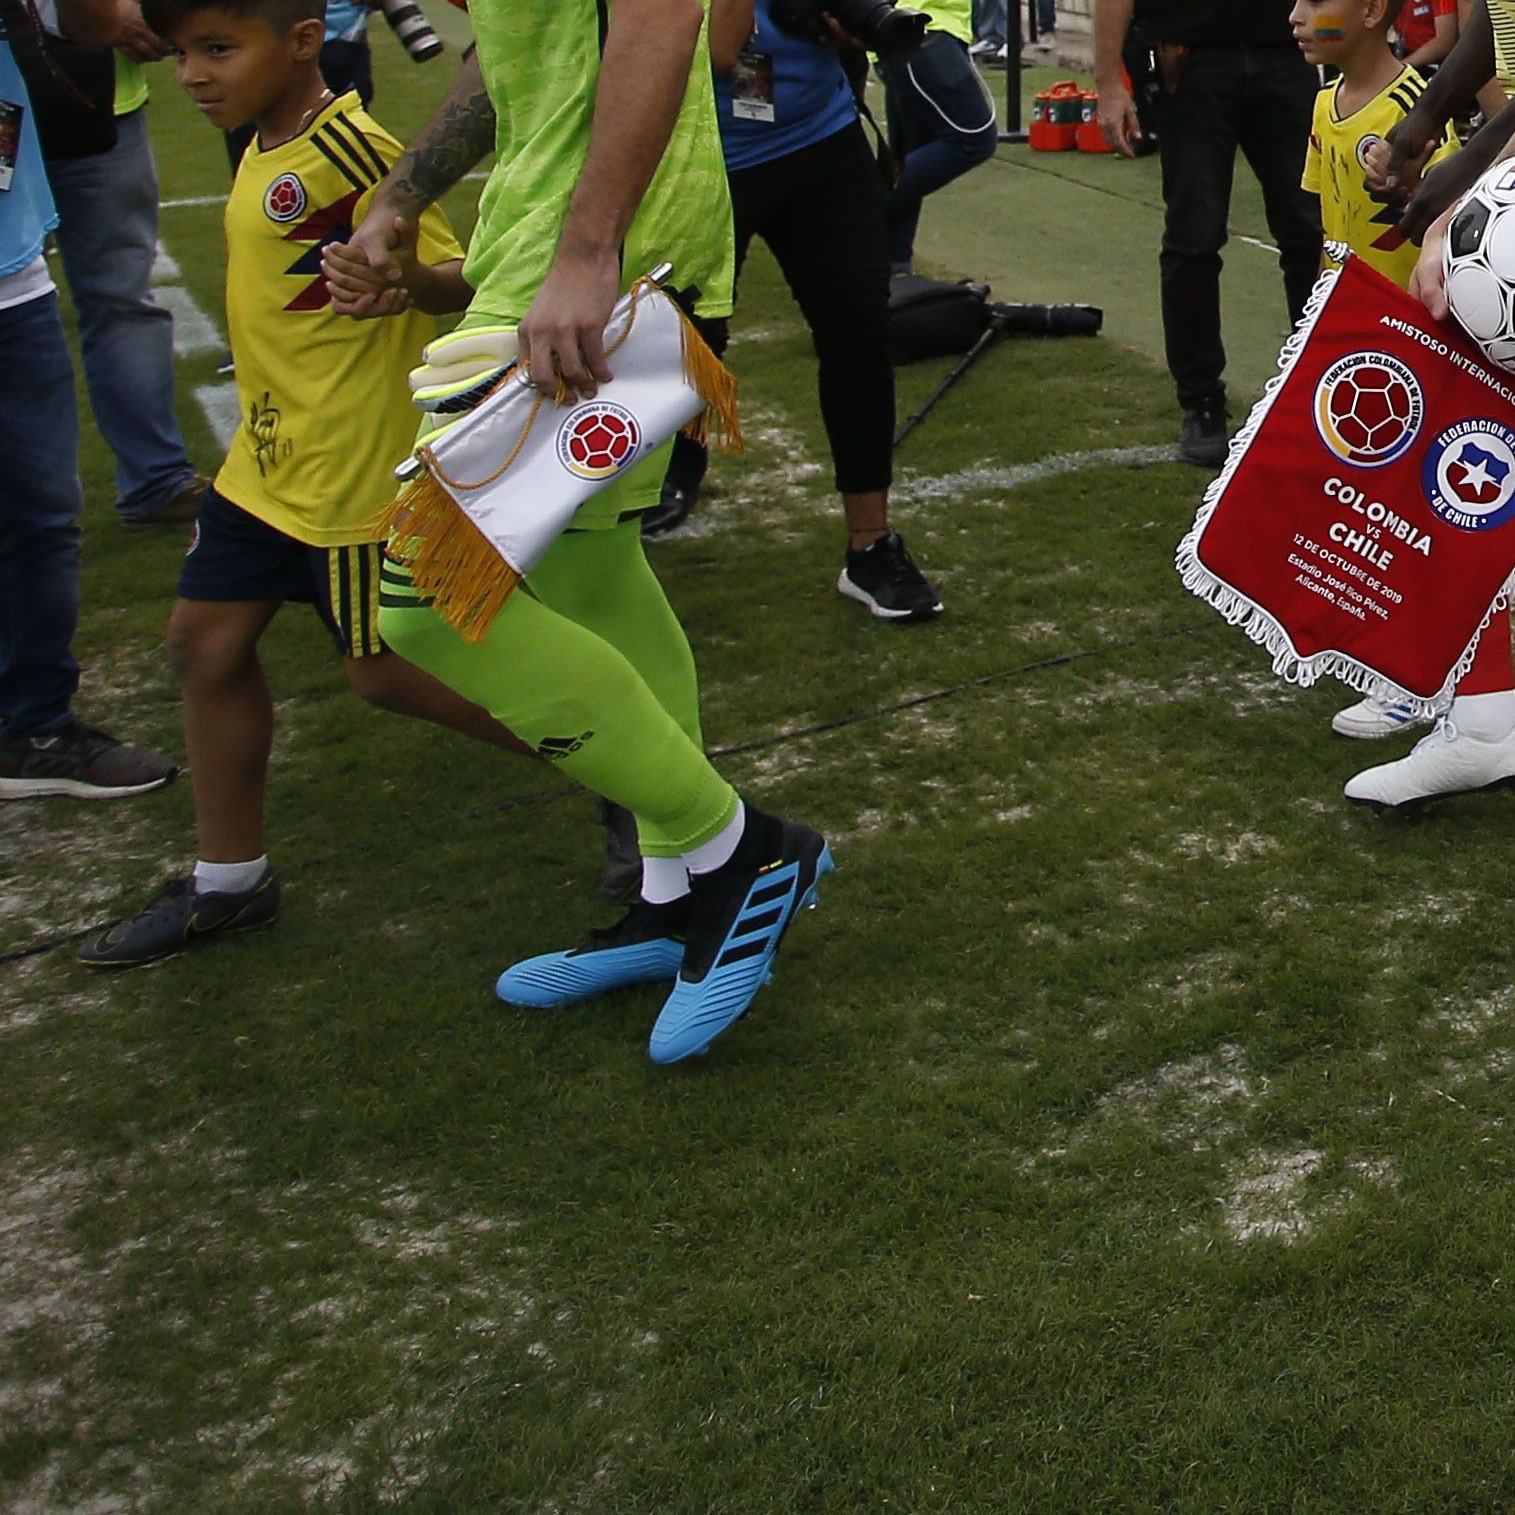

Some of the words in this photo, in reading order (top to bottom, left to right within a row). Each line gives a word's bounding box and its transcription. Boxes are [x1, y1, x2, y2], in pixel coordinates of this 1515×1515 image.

[1379, 315, 1448, 357] AMISTOSO
[1325, 355, 1367, 387] FEDERACION
[1369, 354, 1414, 388] COLOMBIANA
[1437, 420, 1507, 448] FEDERACION
[1323, 477, 1432, 556] COLOMBIA
[1432, 496, 1448, 513] DE
[1445, 508, 1478, 528] CHILE
[1329, 522, 1394, 572] CHILE
[1366, 523, 1382, 539] VS
[1287, 553, 1323, 579] Estadio
[1322, 574, 1347, 592] José
[1293, 533, 1304, 546] 12
[1304, 539, 1320, 554] DE
[1319, 548, 1368, 582] OCTUBRE
[1366, 576, 1383, 591] DE
[1380, 585, 1403, 604] 2019
[1295, 574, 1337, 603] Alicante,
